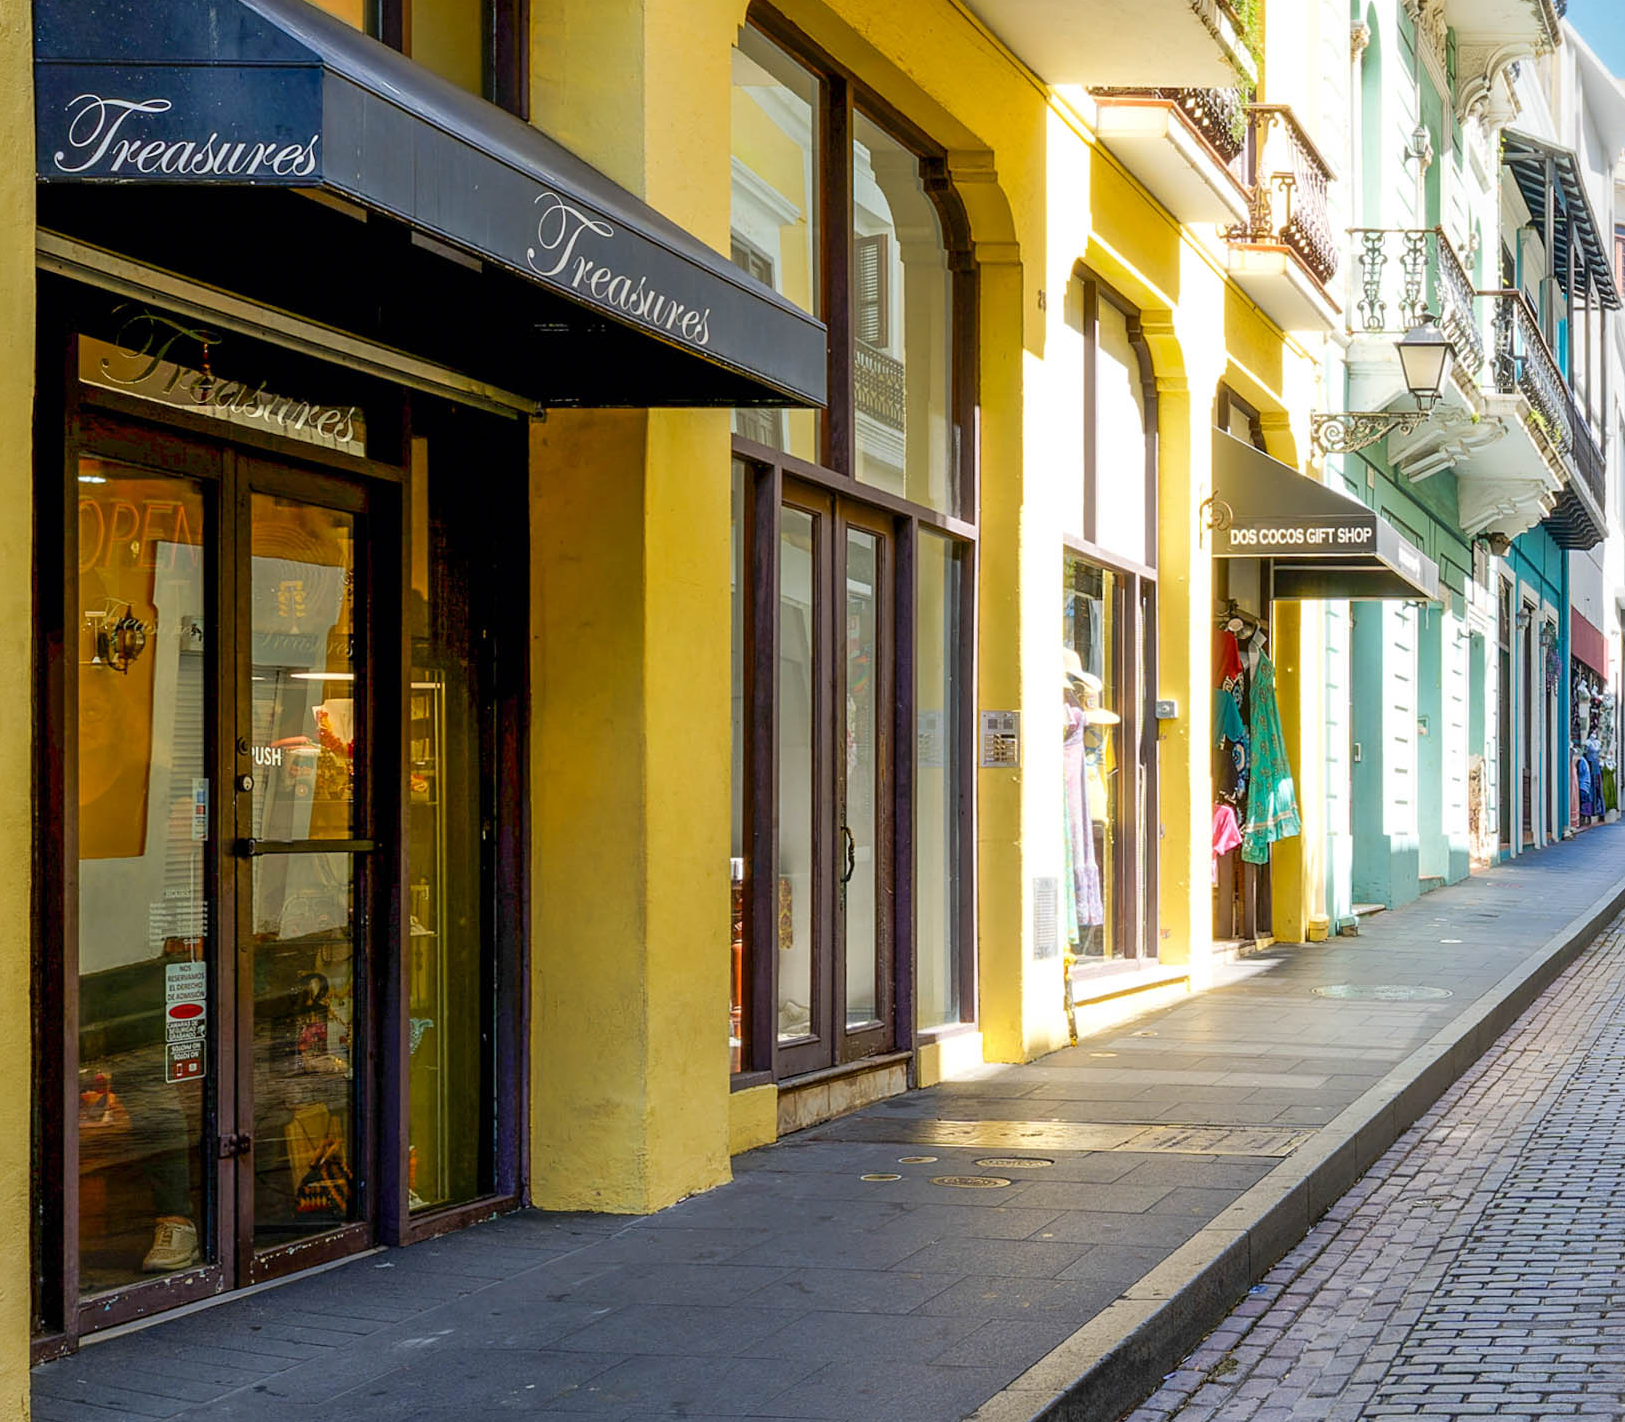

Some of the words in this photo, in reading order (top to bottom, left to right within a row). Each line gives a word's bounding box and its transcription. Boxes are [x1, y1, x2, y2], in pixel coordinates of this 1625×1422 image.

[54, 94, 319, 176] Treasures
[527, 192, 711, 346] Treasures
[101, 303, 356, 443] Treasures
[1230, 529, 1258, 545] DOS
[1259, 528, 1305, 545] COCOS
[1306, 527, 1336, 544] GIFT
[1337, 527, 1372, 544] SHOP
